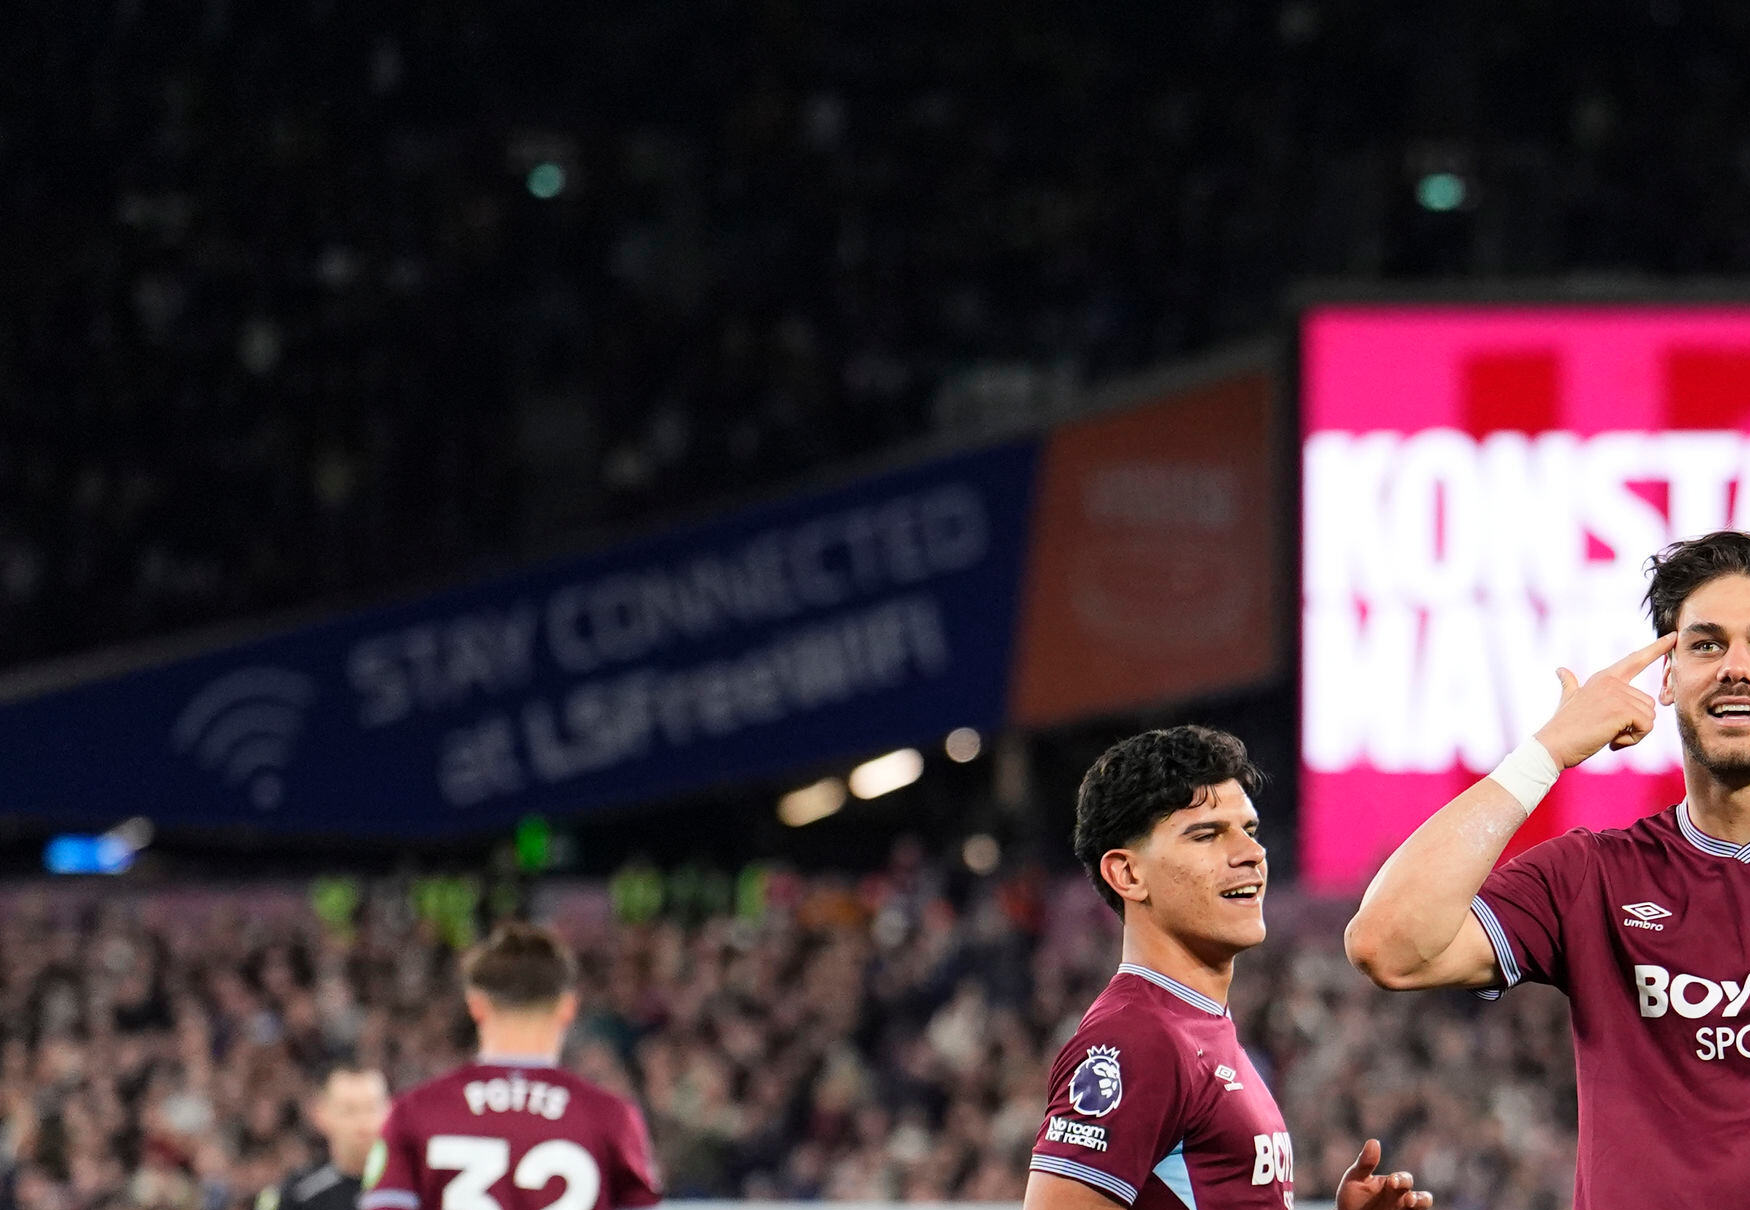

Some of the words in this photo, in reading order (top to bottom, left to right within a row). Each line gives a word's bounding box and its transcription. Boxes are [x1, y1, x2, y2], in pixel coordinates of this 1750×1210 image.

[348, 603, 538, 727] STAY
[545, 484, 988, 672] CONNECTED
[1624, 918, 1664, 931] umbro
[463, 1078, 570, 1120] POTTS
[1049, 1116, 1067, 1131] No
[1067, 1121, 1105, 1139] room
[1045, 1129, 1064, 1142] for
[1063, 1132, 1108, 1152] racism
